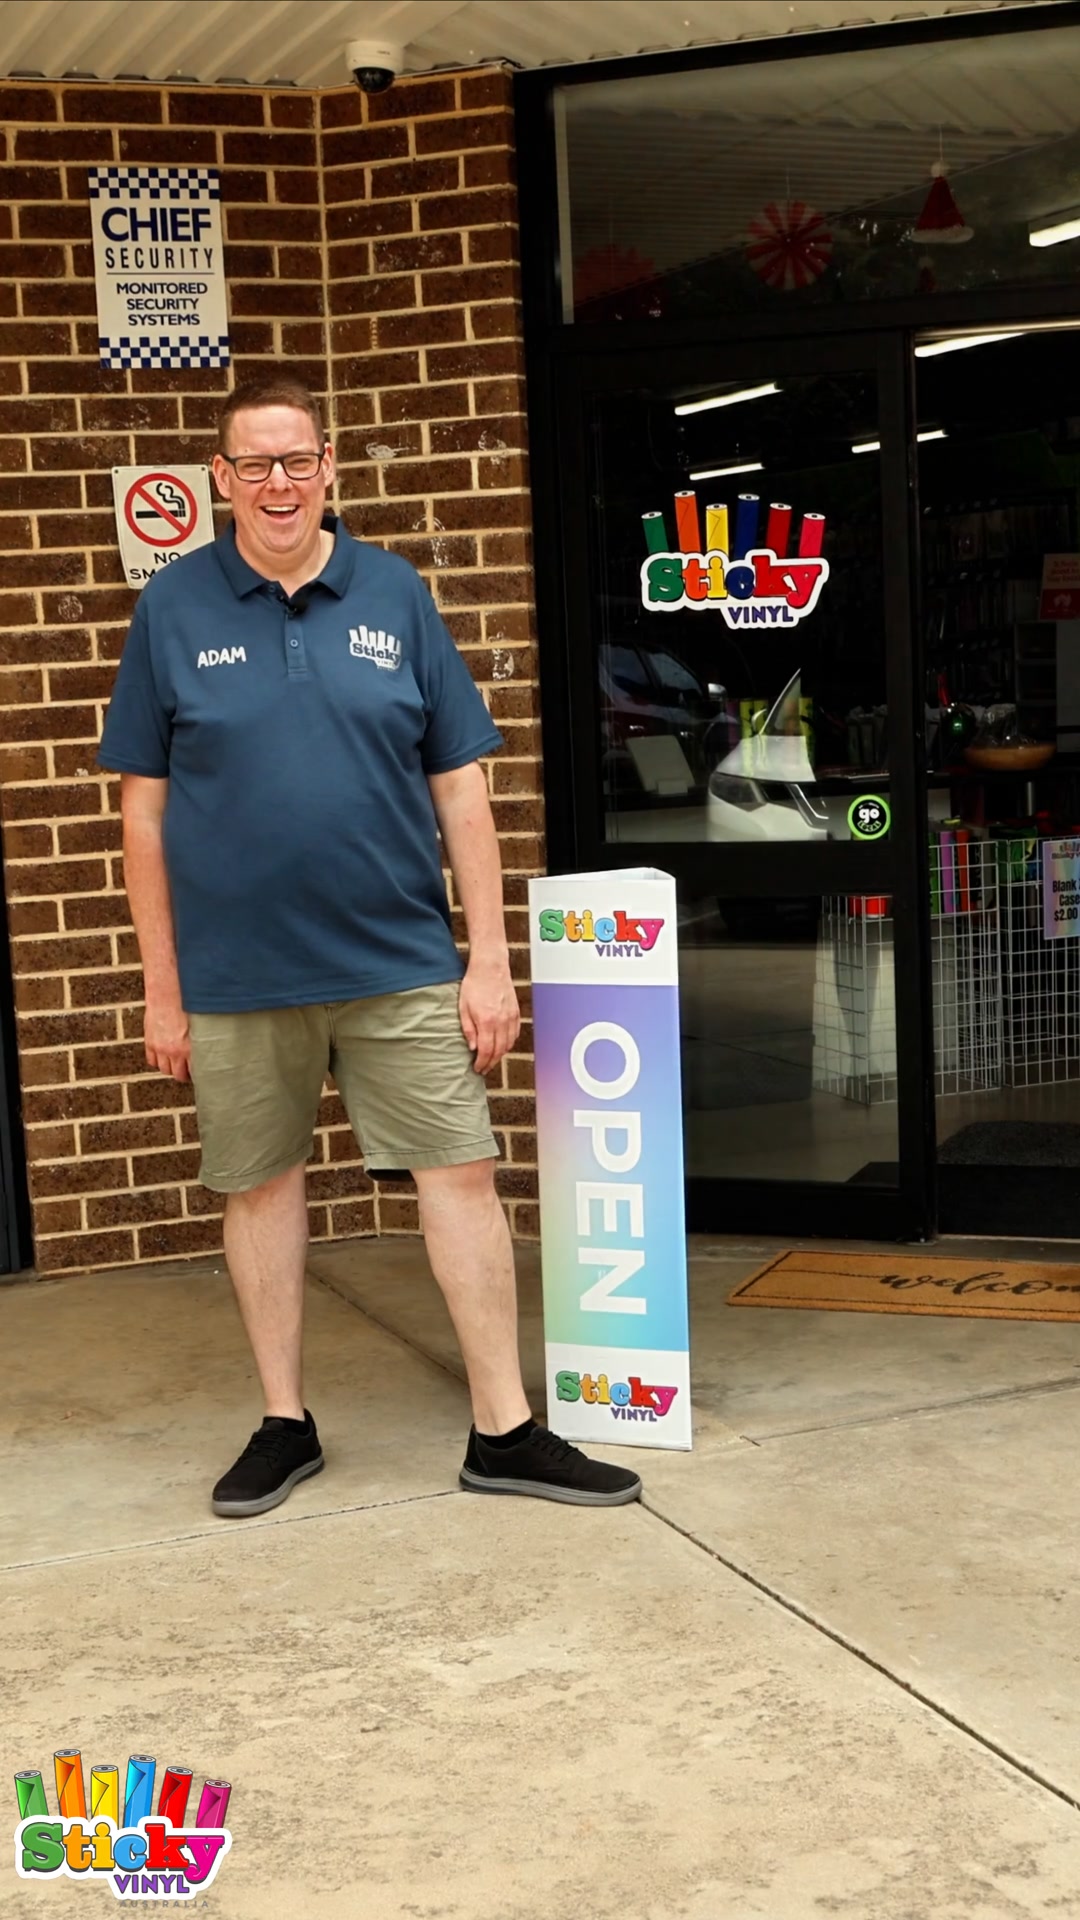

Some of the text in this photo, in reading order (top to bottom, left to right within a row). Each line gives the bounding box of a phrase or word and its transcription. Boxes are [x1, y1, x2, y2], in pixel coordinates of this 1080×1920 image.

[101, 207, 212, 242] CHIEF
[105, 247, 213, 269] SECURITY
[116, 282, 208, 295] MONITORED
[126, 298, 199, 311] SECURITY
[128, 313, 201, 326] SYSTEMS
[647, 555, 823, 609] Sticky
[727, 605, 794, 625] VINYL
[197, 646, 247, 669] ADAM
[352, 642, 401, 666] Sticky
[858, 808, 880, 824] go
[1052, 879, 1077, 893] Blank
[1053, 907, 1078, 922] $2.00
[539, 909, 665, 951] Sticky
[595, 944, 644, 958] VINYL
[570, 1021, 648, 1315] OPEN
[555, 1370, 678, 1417] Sticky
[610, 1407, 658, 1422] VINYL
